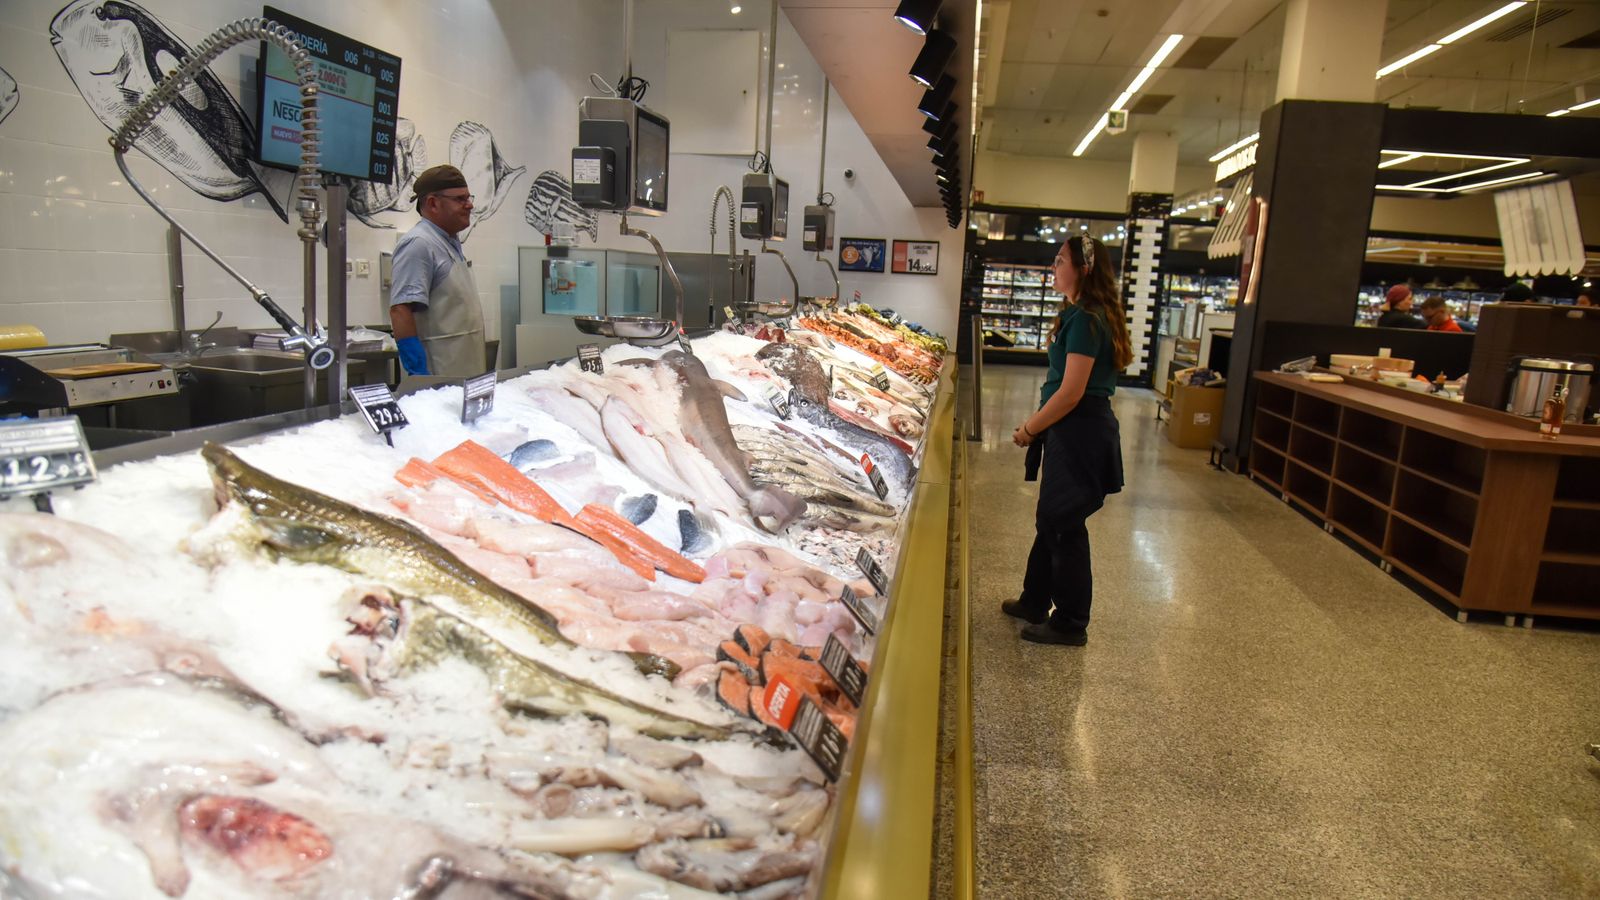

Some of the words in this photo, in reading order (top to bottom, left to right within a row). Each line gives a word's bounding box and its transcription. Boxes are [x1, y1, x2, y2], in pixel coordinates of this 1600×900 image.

[344, 50, 358, 65] 006
[380, 69, 394, 83] 005
[378, 102, 391, 115] 001
[376, 132, 389, 145] 025
[374, 163, 387, 175] 013
[768, 682, 791, 720] OFERTA
